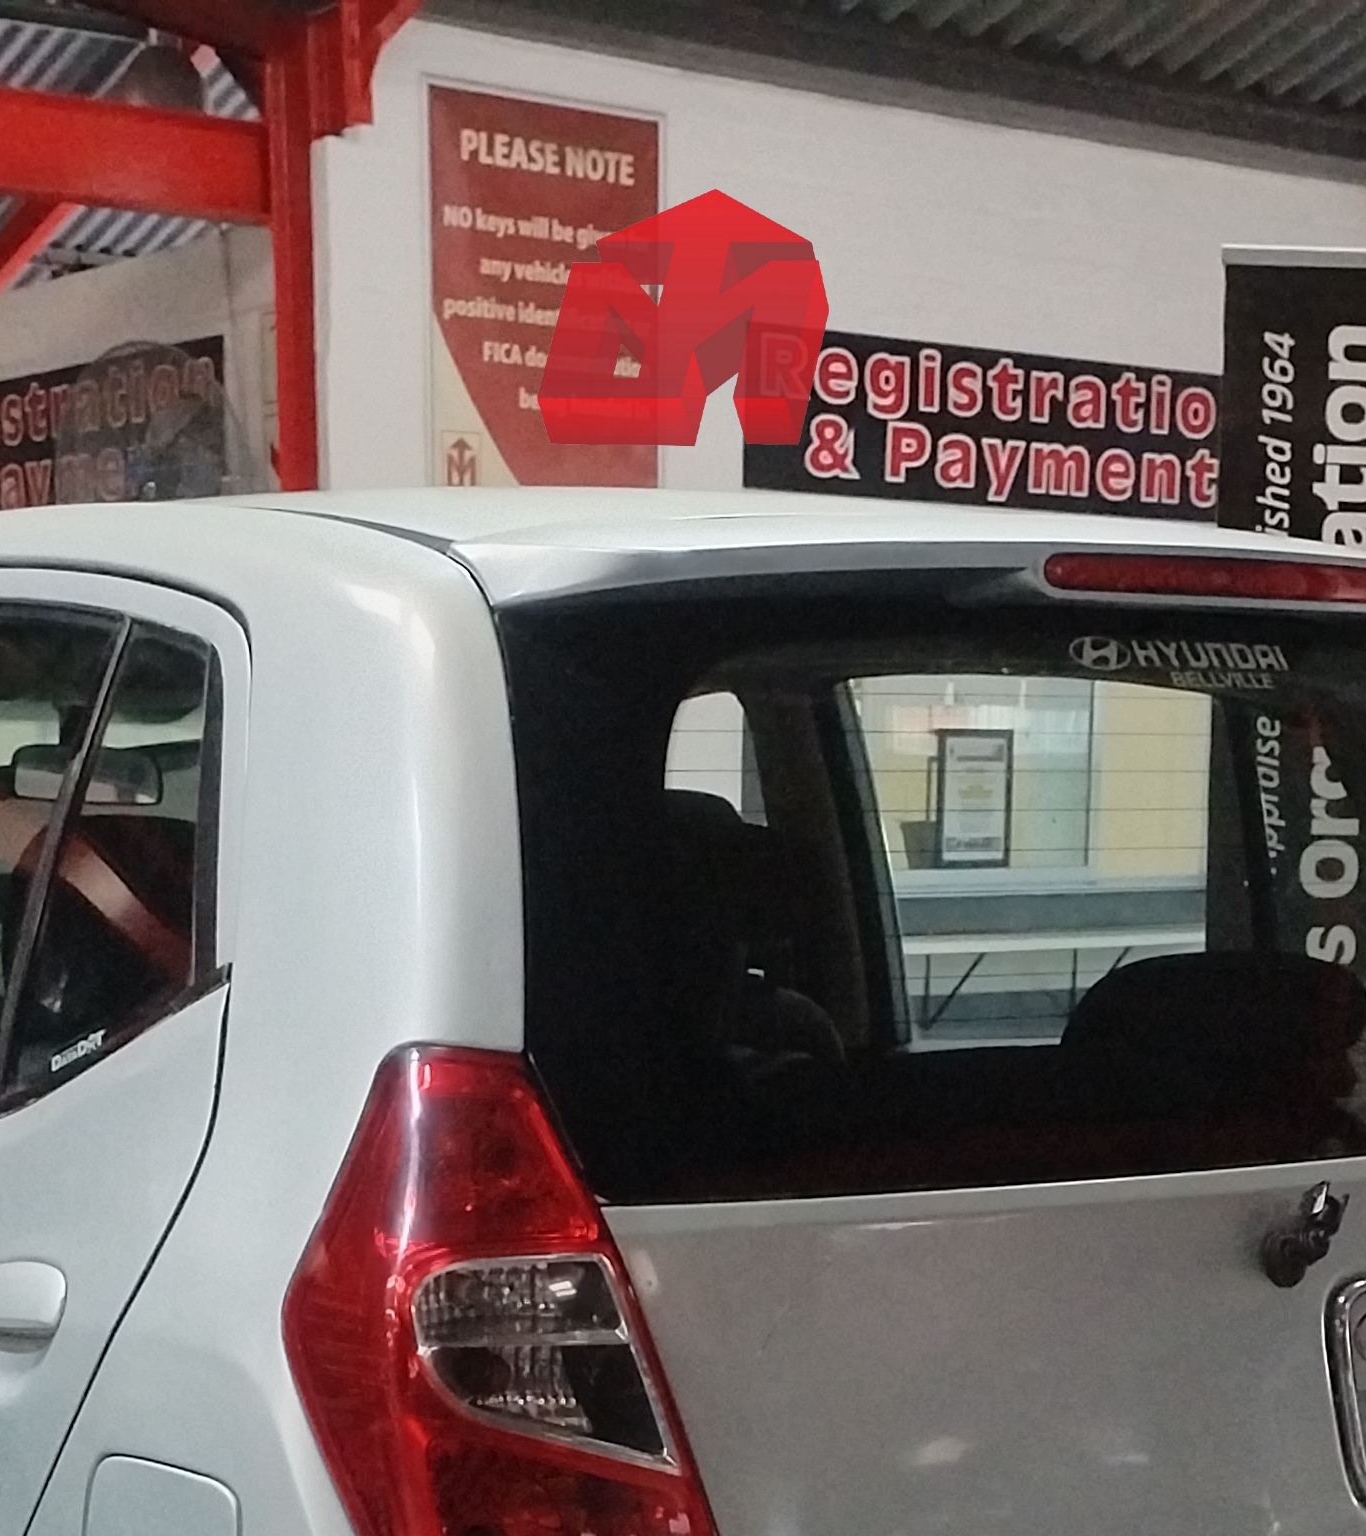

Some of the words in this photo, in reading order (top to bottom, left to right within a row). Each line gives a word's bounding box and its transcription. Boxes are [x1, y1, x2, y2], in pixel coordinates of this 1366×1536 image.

[459, 128, 561, 175] PLEASE
[564, 146, 635, 186] NOTE
[443, 204, 473, 228] NO
[475, 207, 515, 238] keys
[517, 215, 550, 240] will
[551, 219, 574, 243] be
[480, 258, 514, 282] any
[443, 296, 516, 320] positive
[483, 341, 523, 366] FICA
[1261, 331, 1296, 425] 1964
[804, 413, 861, 480] &
[884, 420, 1220, 509] Payment
[1132, 640, 1289, 671] HYUNDAI
[1170, 671, 1277, 689] BELLVILLE
